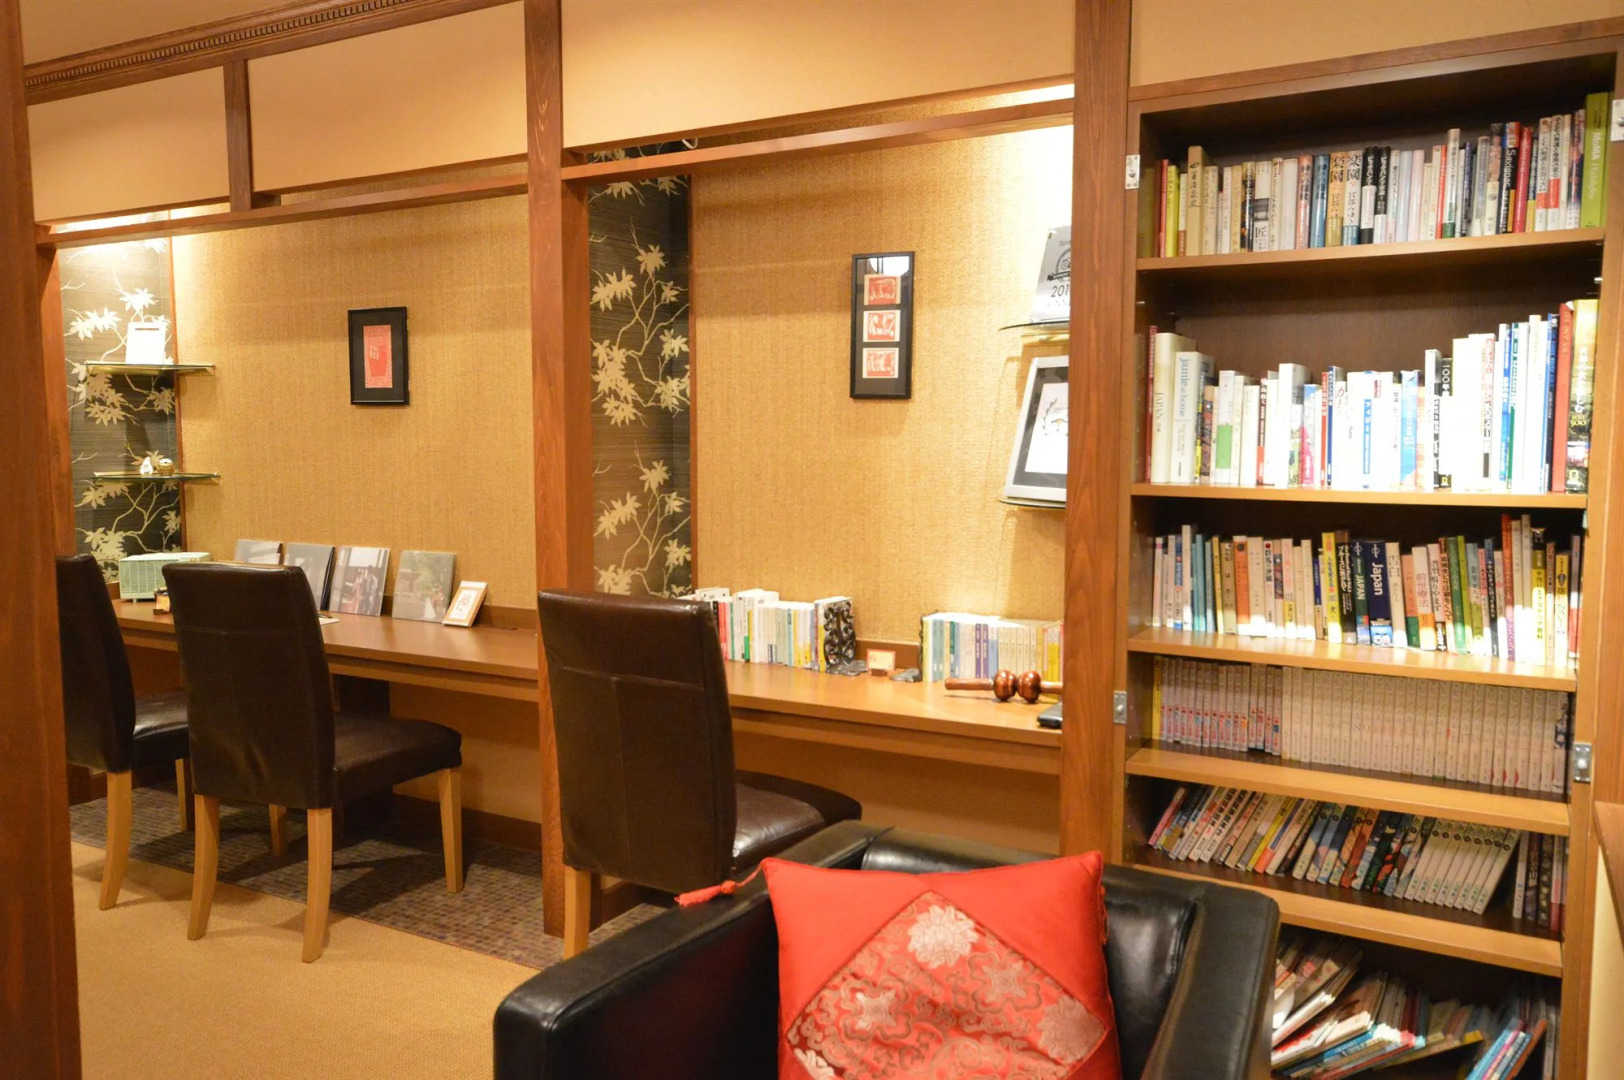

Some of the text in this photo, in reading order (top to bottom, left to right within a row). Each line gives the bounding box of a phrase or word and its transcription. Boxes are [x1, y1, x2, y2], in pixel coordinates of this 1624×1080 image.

[1591, 131, 1601, 160] MoMA
[1506, 149, 1517, 187] Savignac
[1051, 284, 1069, 297] 201
[1179, 356, 1191, 387] jamie
[1155, 392, 1164, 420] JAPAN
[1356, 574, 1365, 600] JAPAN
[1371, 562, 1384, 596] Japan
